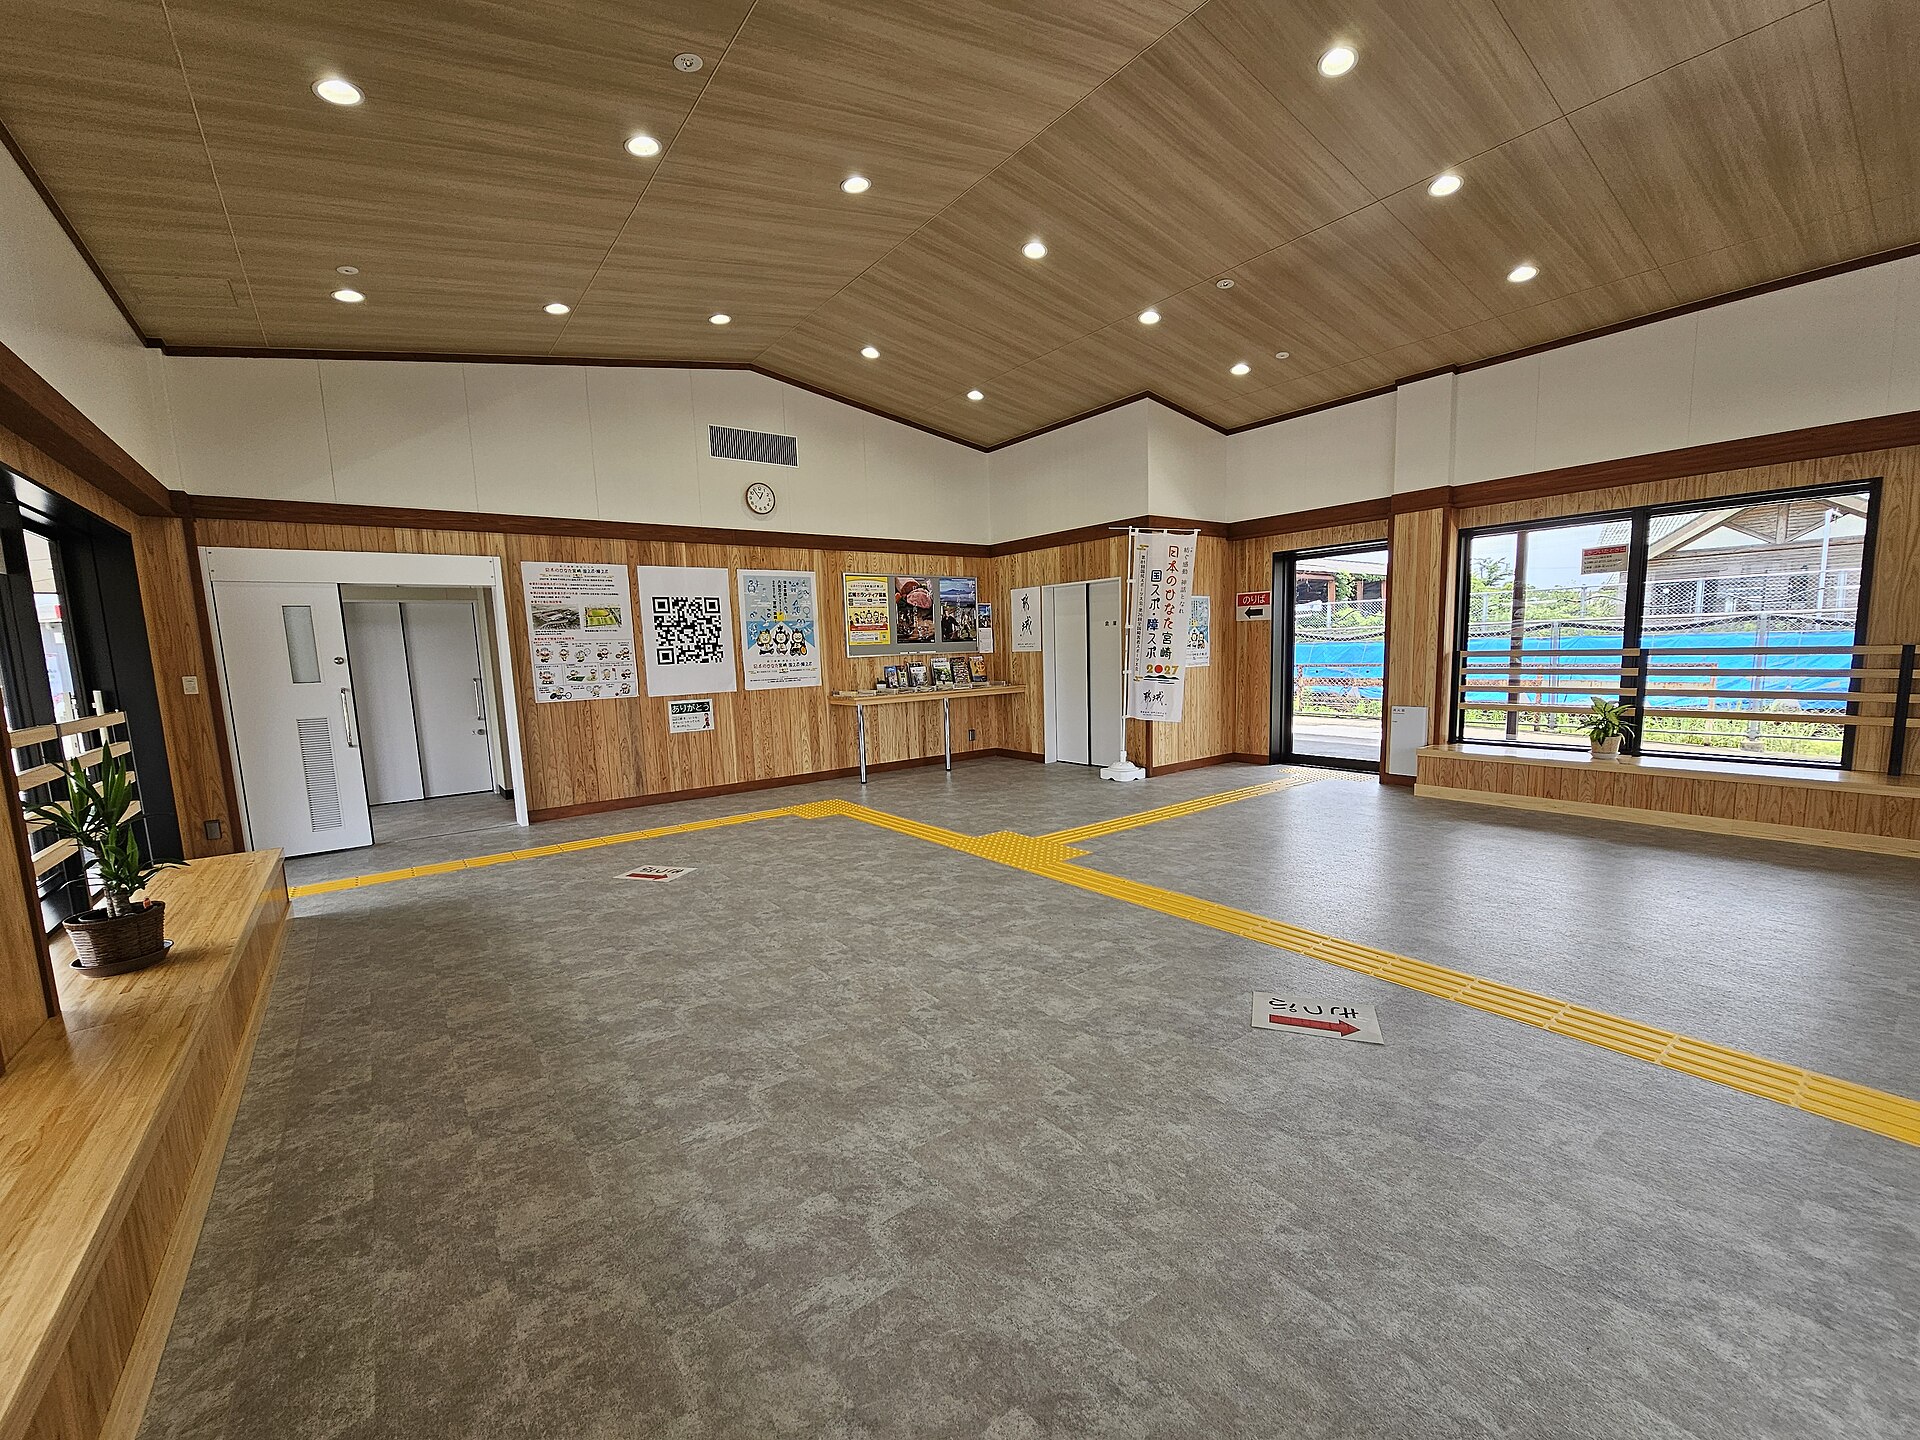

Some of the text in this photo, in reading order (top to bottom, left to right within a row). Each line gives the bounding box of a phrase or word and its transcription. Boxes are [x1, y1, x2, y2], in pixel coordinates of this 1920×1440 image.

[1146, 570, 1162, 659] 国スポ・障スポ
[1160, 546, 1179, 660] 日本のひなた宮崎
[1243, 594, 1265, 604] のりば
[672, 703, 709, 713] ありがとう
